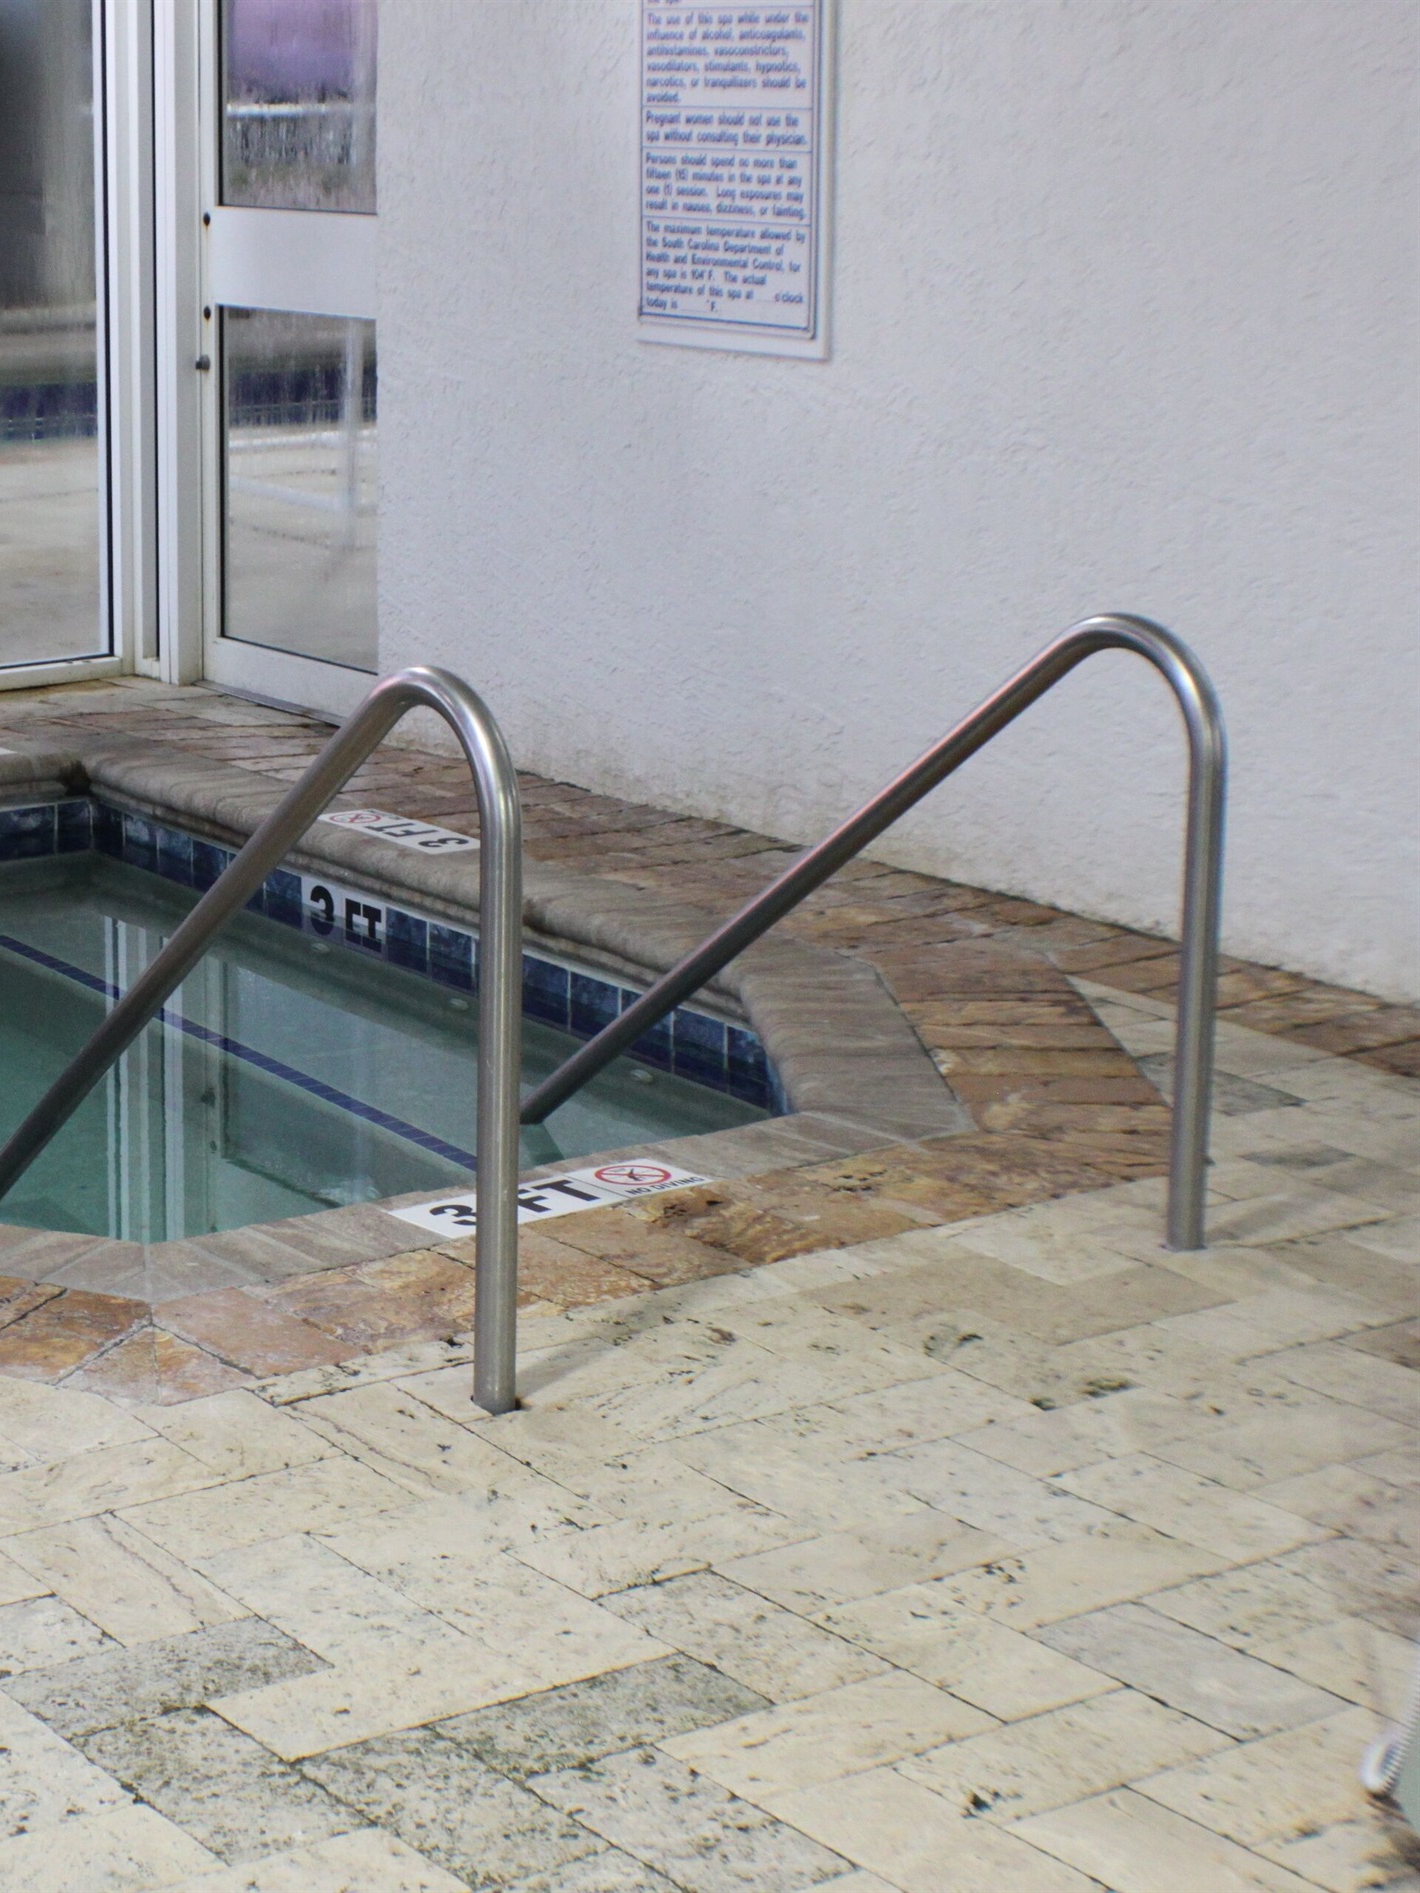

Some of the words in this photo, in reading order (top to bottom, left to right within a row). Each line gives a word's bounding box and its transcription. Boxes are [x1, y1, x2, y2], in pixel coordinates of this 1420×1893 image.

[647, 13, 661, 25] The
[667, 15, 680, 24] use
[686, 14, 694, 24] of
[698, 13, 713, 24] this
[718, 15, 733, 26] spa
[738, 13, 760, 23] while
[765, 12, 790, 23] under
[795, 12, 809, 23] the
[647, 29, 683, 40] influence
[689, 29, 697, 40] of
[691, 79, 699, 87] or
[762, 77, 791, 88] should
[795, 77, 807, 88] be
[646, 111, 680, 127] Pregnant
[685, 113, 713, 124] women
[718, 112, 745, 126] should
[749, 113, 763, 126] not
[767, 116, 781, 126] use
[785, 113, 799, 127] the
[647, 131, 659, 143] spa
[664, 129, 692, 142] without
[697, 130, 739, 145] consulting
[743, 131, 761, 143] their
[646, 152, 677, 164] Persons
[681, 153, 706, 165] should
[711, 155, 735, 168] spend
[739, 158, 749, 167] no
[754, 158, 775, 168] more
[779, 158, 797, 169] than
[646, 167, 671, 179] fifteen
[693, 169, 724, 182] minutes
[728, 172, 736, 182] in
[740, 171, 753, 183] the
[757, 173, 771, 185] spa
[776, 173, 784, 184] at
[787, 174, 802, 188] any
[646, 186, 660, 195] one
[716, 186, 736, 200] Long
[740, 189, 782, 200] exposures
[787, 190, 804, 203] may
[646, 199, 667, 210] result
[672, 201, 679, 210] in
[760, 206, 769, 215] or
[646, 221, 660, 233] The
[664, 223, 703, 235] maximum
[706, 225, 755, 238] temperature
[760, 228, 792, 240] allowed
[796, 230, 806, 243] by
[646, 236, 658, 247] the
[662, 237, 684, 249] South
[688, 238, 720, 251] Carolina
[724, 240, 772, 254] Department
[776, 244, 785, 255] of
[646, 252, 670, 264] Health
[673, 253, 687, 265] and
[692, 254, 748, 268] Environmental
[789, 261, 802, 272] for
[646, 268, 659, 279] any
[663, 269, 677, 280] spa
[681, 270, 687, 279] is
[724, 271, 738, 283] The
[742, 273, 766, 285] actual
[646, 282, 693, 295] temperature
[697, 284, 706, 295] of
[709, 285, 724, 297] this
[727, 288, 742, 299] spa
[745, 289, 754, 300] at
[646, 298, 667, 310] today
[671, 298, 678, 309] is
[365, 822, 439, 838] FT
[418, 837, 469, 848] 3
[625, 1186, 650, 1195] NO
[653, 1176, 705, 1190] DIVING
[517, 1179, 601, 1213] FT
